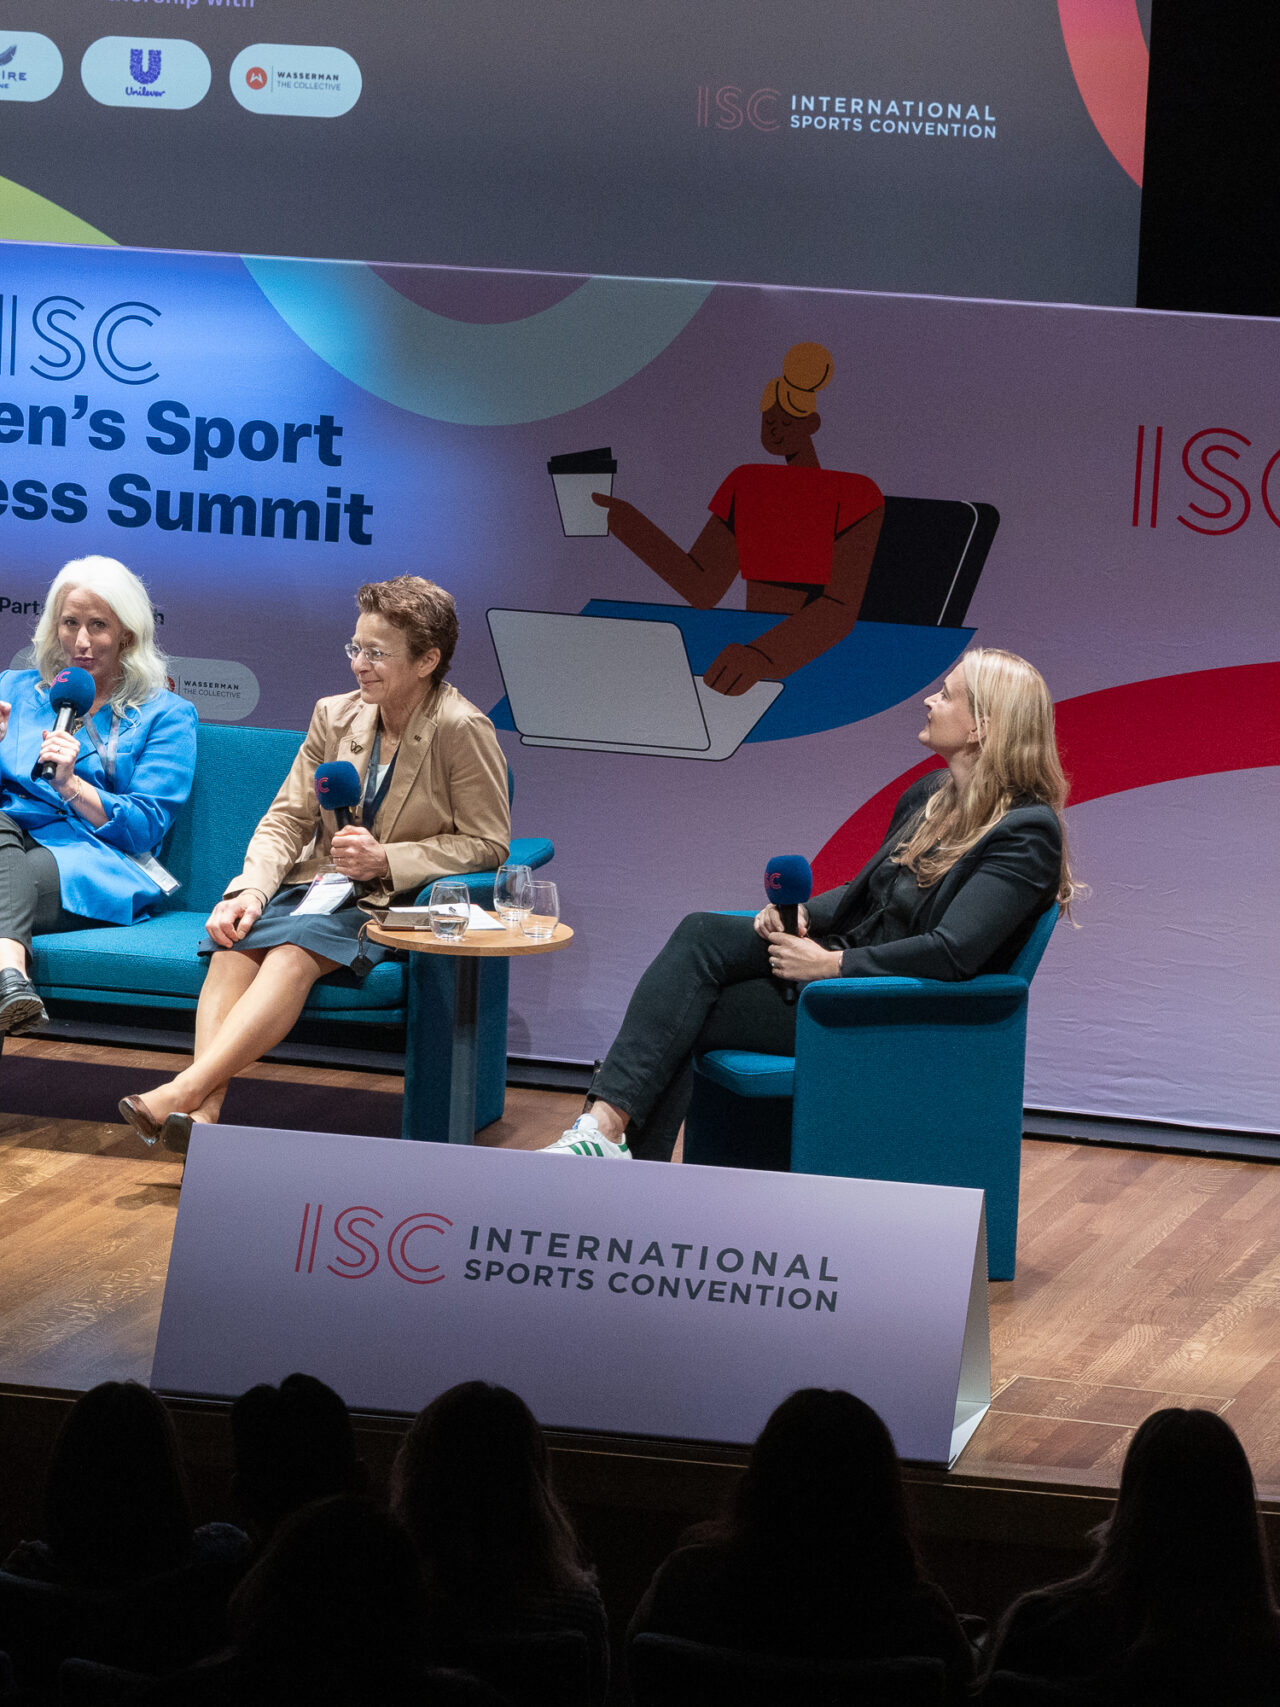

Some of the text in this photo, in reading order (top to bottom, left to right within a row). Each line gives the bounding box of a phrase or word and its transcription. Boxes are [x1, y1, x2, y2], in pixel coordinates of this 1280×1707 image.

[125, 86, 166, 97] Unilever
[277, 71, 340, 81] WASSERMAN
[277, 80, 341, 91] THE COLLECTIVE
[697, 85, 782, 132] ISC
[790, 114, 997, 139] SPORTS CONVENTION
[791, 94, 997, 122] INTERNATIONAL
[146, 399, 344, 472] Sport
[1131, 424, 1280, 536] IS
[107, 472, 374, 546] Summit
[183, 680, 239, 690] WASSERMAN
[198, 689, 241, 699] COLLECTIVE
[295, 1203, 454, 1285] ISC
[469, 1225, 839, 1282] INTERNATIONAL
[464, 1258, 839, 1312] SPORTS CONVENTION
